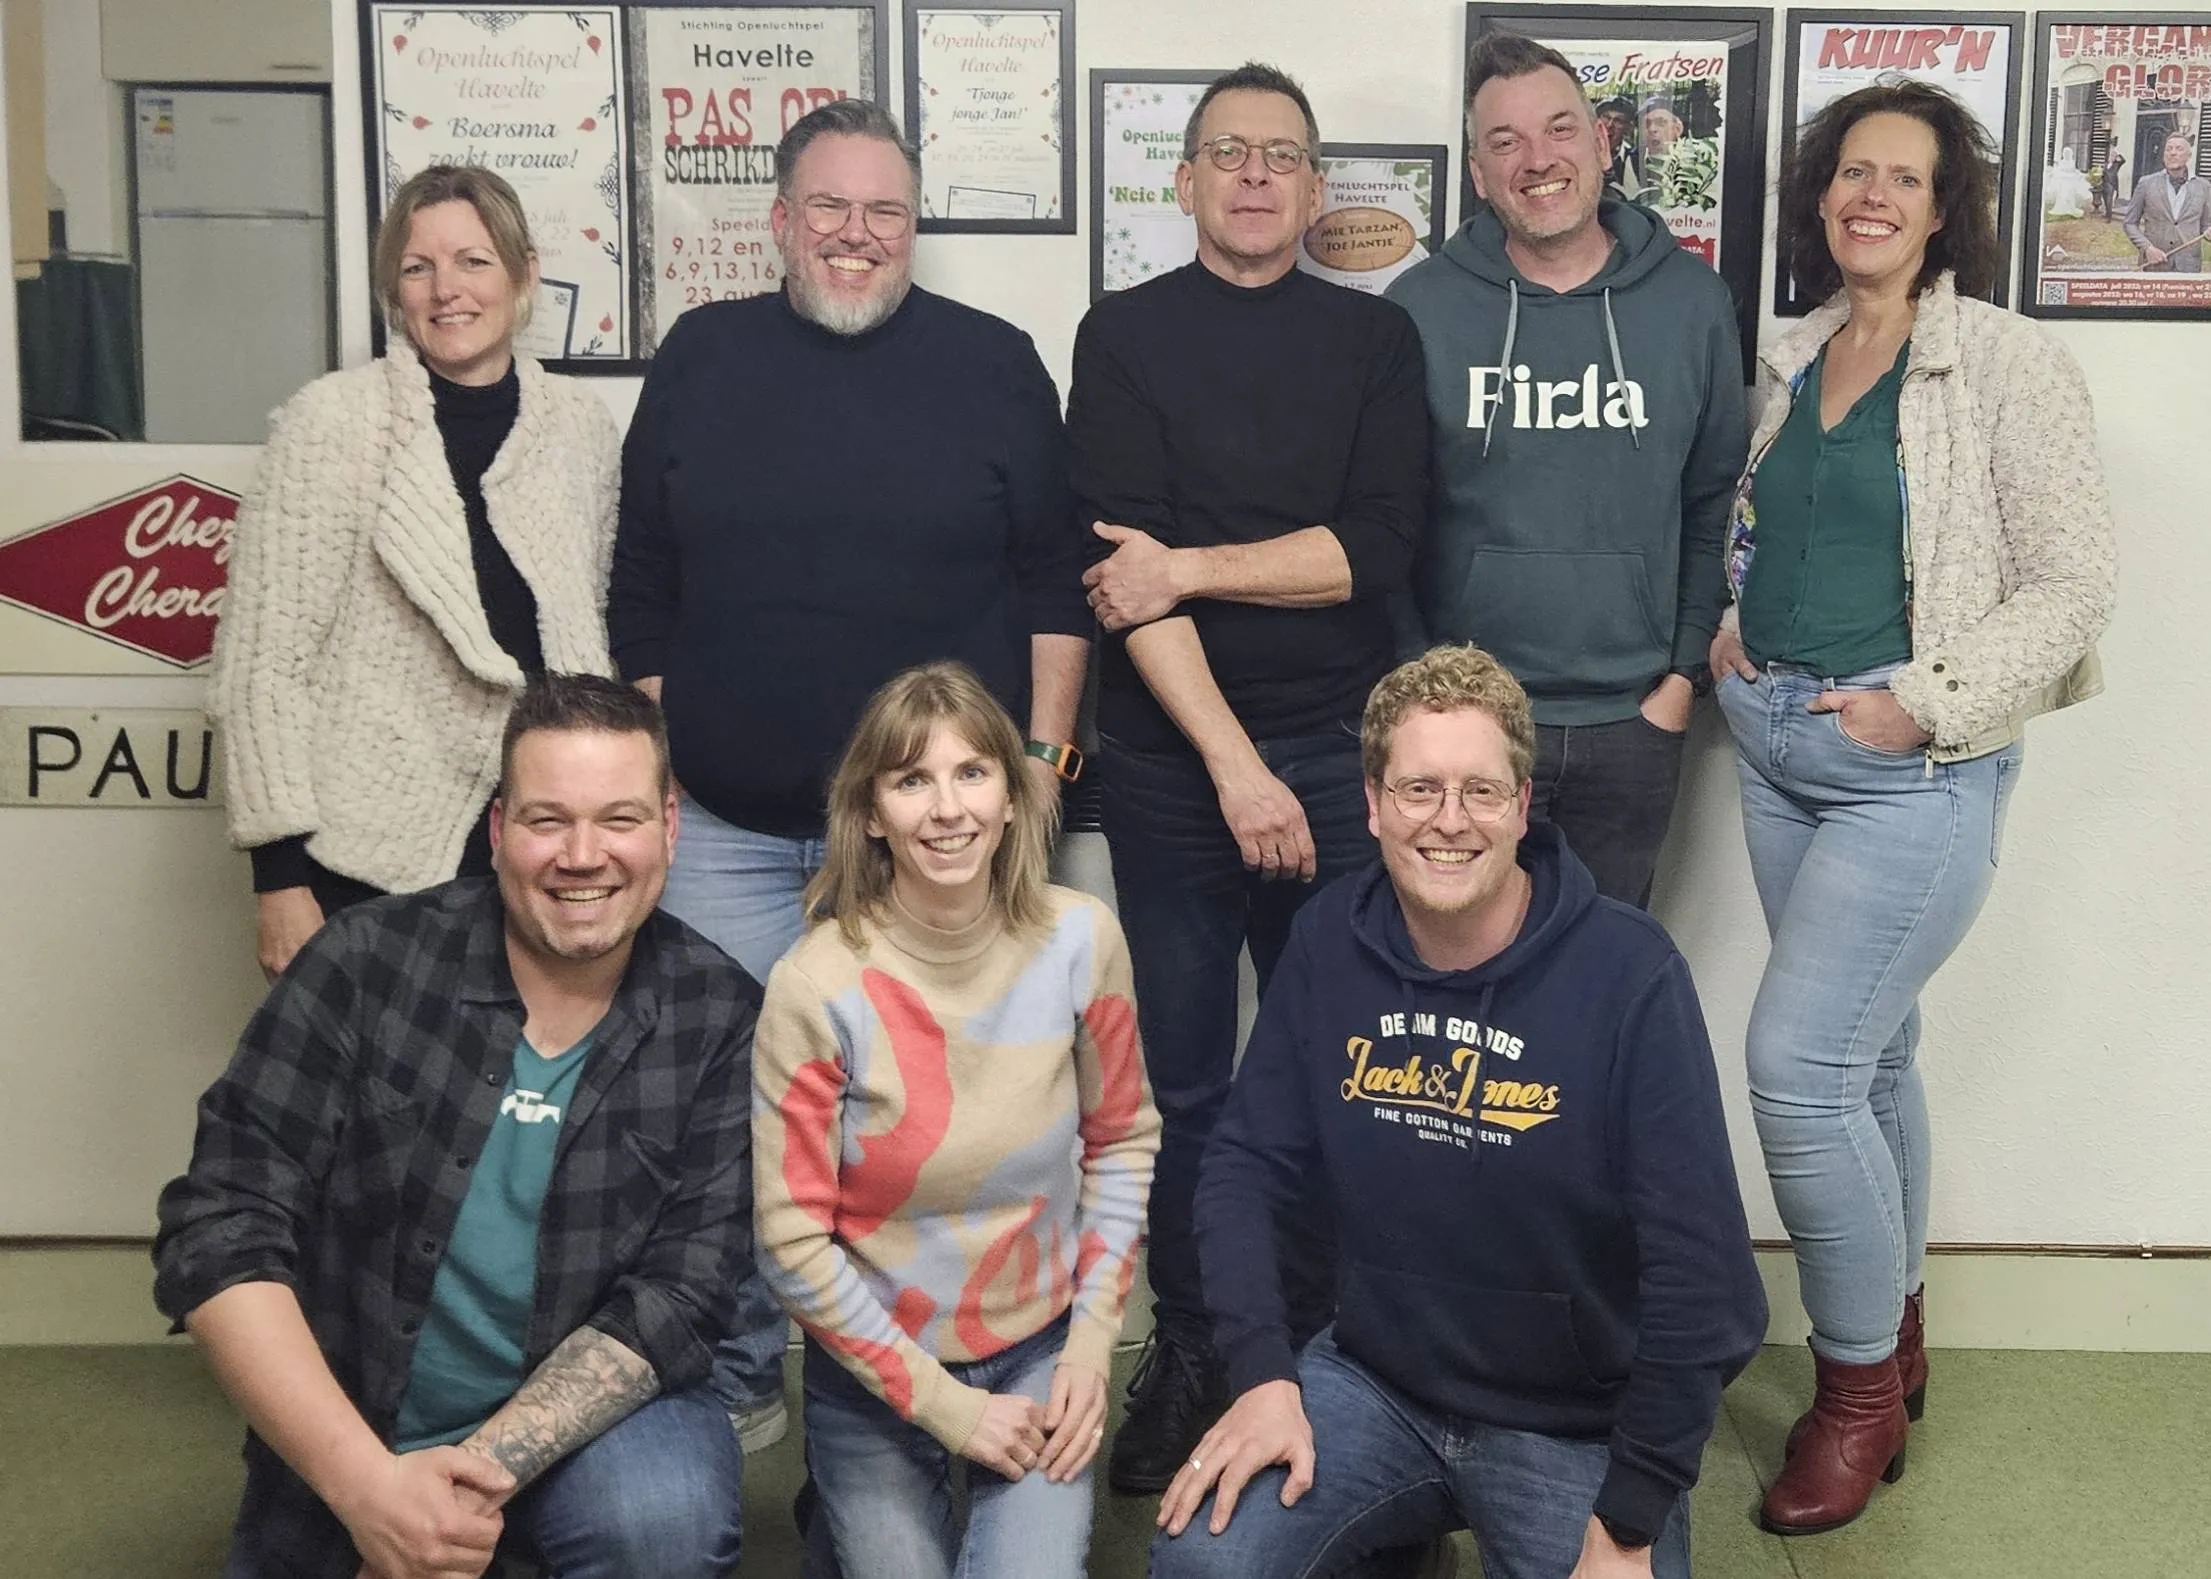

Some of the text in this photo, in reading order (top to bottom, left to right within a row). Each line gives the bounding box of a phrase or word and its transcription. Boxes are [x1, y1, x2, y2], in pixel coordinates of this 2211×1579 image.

[680, 21, 824, 31] Stichting Openluchtspel
[932, 31, 1048, 53] Openluchtspel
[1817, 25, 1996, 73] KUUR'N
[417, 45, 581, 74] Openluchtspel
[693, 44, 814, 67] Havelte
[960, 56, 1022, 73] Havelte
[1618, 50, 1724, 82] Fratsen
[455, 75, 547, 99] Havelte
[662, 87, 754, 146] PAS
[950, 106, 988, 122] jonge
[448, 117, 557, 138] Boersma
[428, 145, 579, 168] zoekt vrouw!
[733, 241, 763, 255] en
[1326, 241, 1348, 252] JOE
[685, 286, 712, 304] 23
[1466, 364, 1650, 429] Firda
[28, 726, 213, 800] PAU
[1374, 1107, 1512, 1146] FINE COTTON GARENTS
[1418, 1129, 1453, 1144] QUALITY
